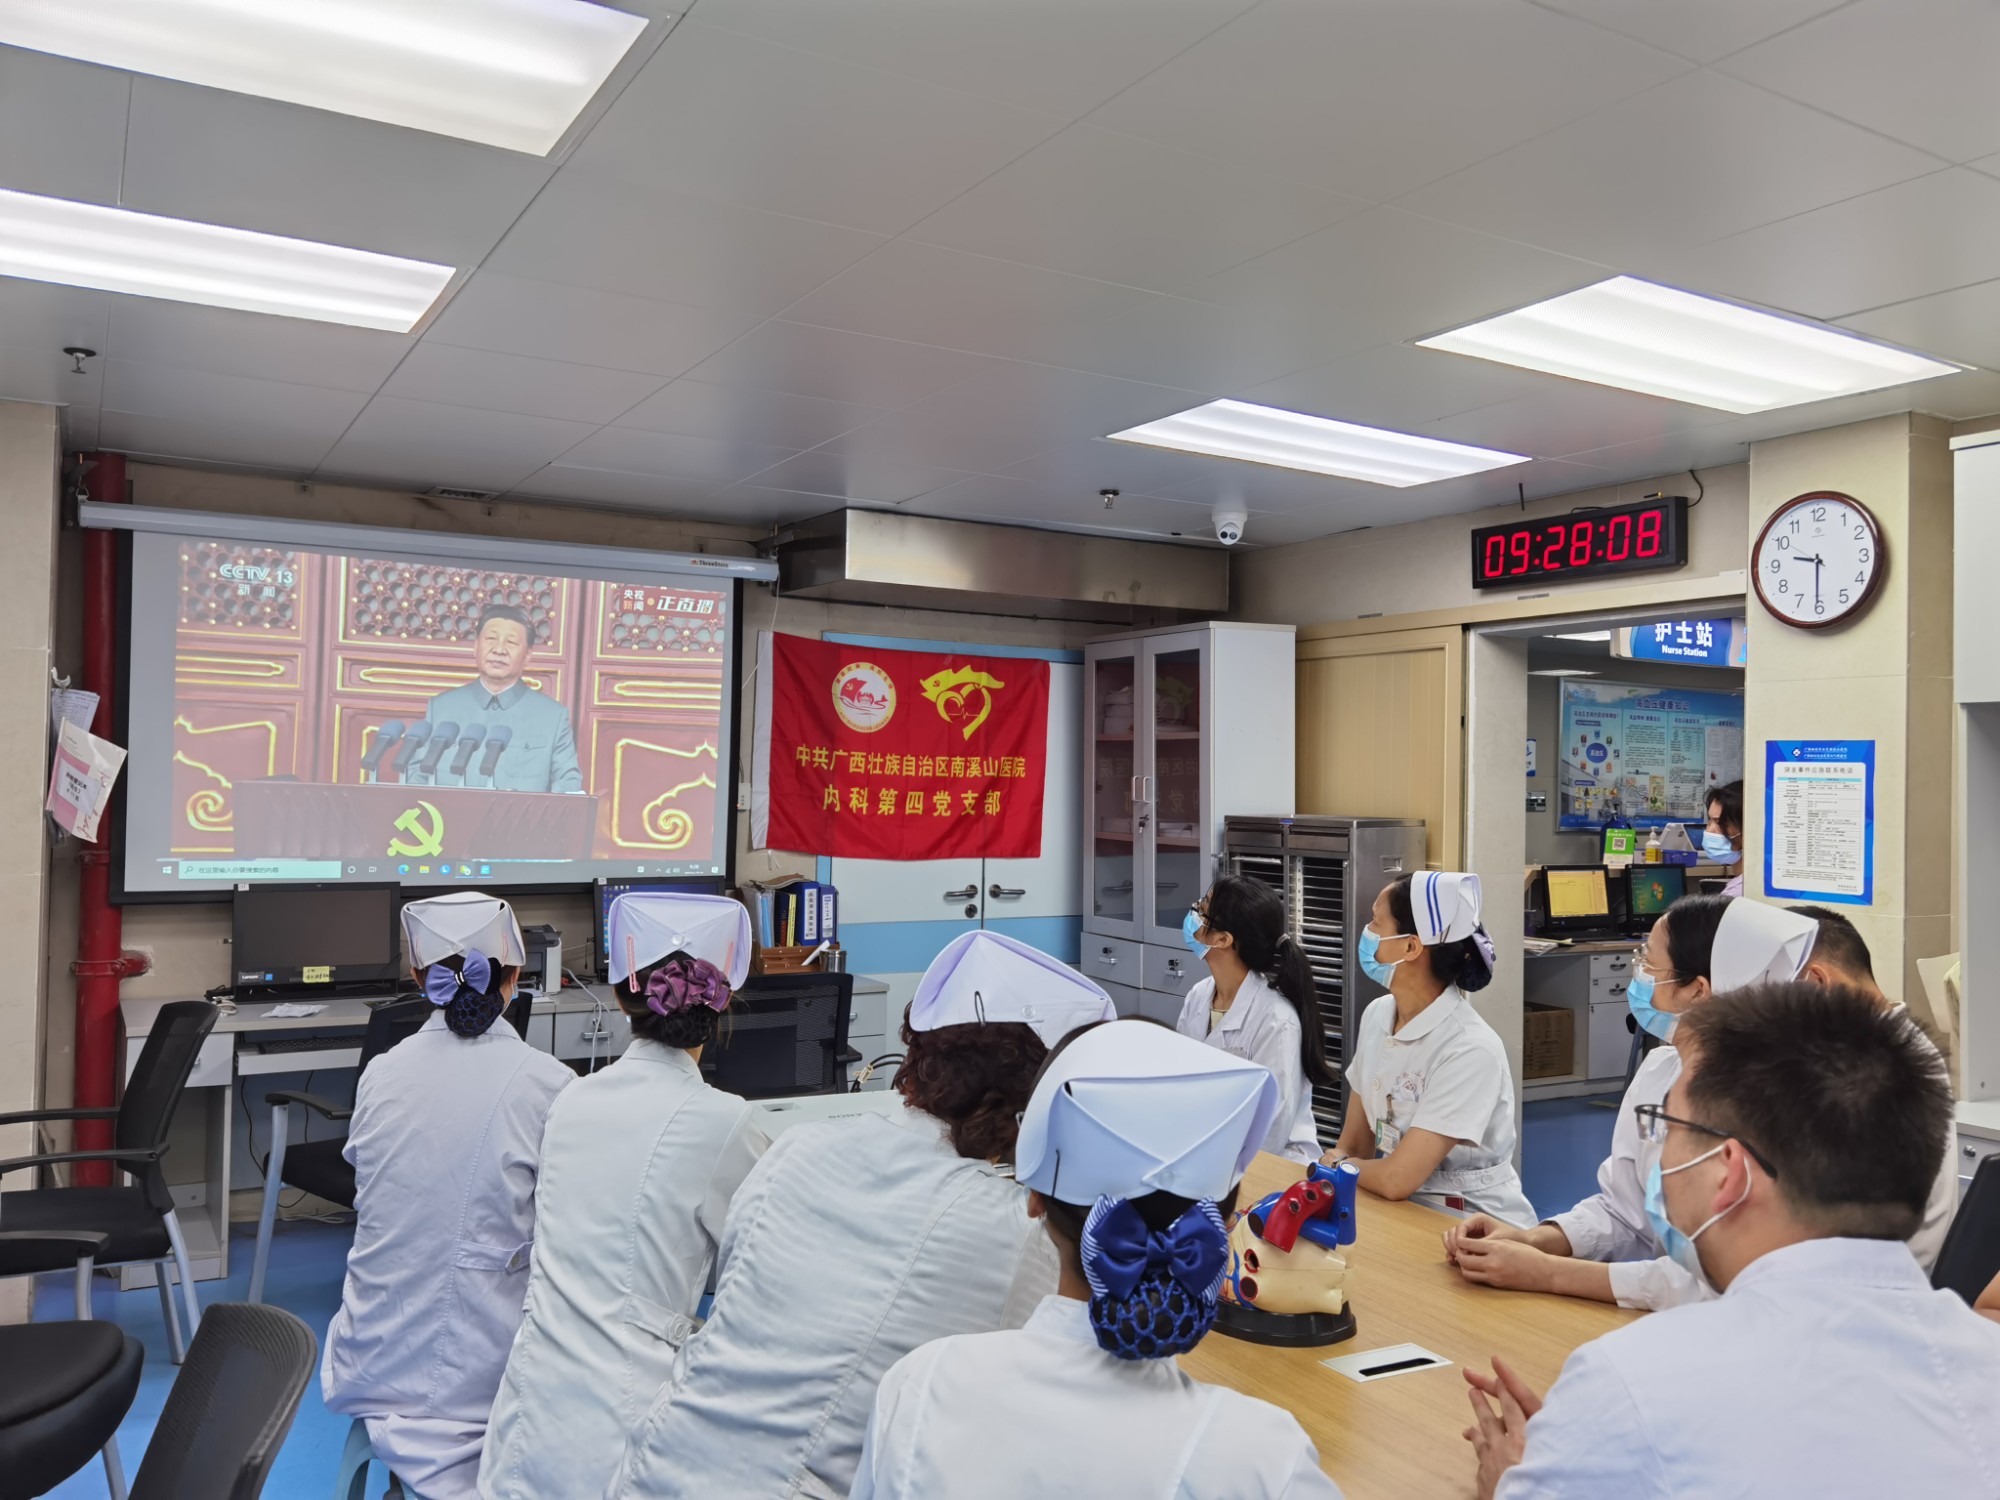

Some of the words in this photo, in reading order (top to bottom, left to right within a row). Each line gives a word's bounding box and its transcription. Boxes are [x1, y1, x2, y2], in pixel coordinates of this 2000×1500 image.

[1810, 507, 1826, 522] 12
[1840, 512, 1847, 527] 1
[1789, 519, 1800, 534] 11
[1853, 525, 1865, 540] 2
[1484, 510, 1662, 578] 09:28:08
[1775, 535, 1790, 551] 10
[1858, 548, 1870, 563] 3
[219, 563, 271, 581] CCTV
[276, 570, 293, 584] 13
[1770, 559, 1781, 574] 9
[1854, 571, 1866, 585] 4
[1778, 579, 1789, 594] 8
[623, 589, 645, 600] 央视
[1794, 593, 1805, 609] 7
[1838, 588, 1849, 604] 5
[656, 595, 715, 614] 正直播
[1814, 600, 1825, 615] 6
[1655, 621, 1713, 647] 护士站
[1661, 645, 1683, 655] Nurse
[1683, 646, 1708, 657] Station
[795, 743, 1026, 778] 中共广西壮族自治区南溪山医院
[822, 783, 1001, 817] 内科第四党支部
